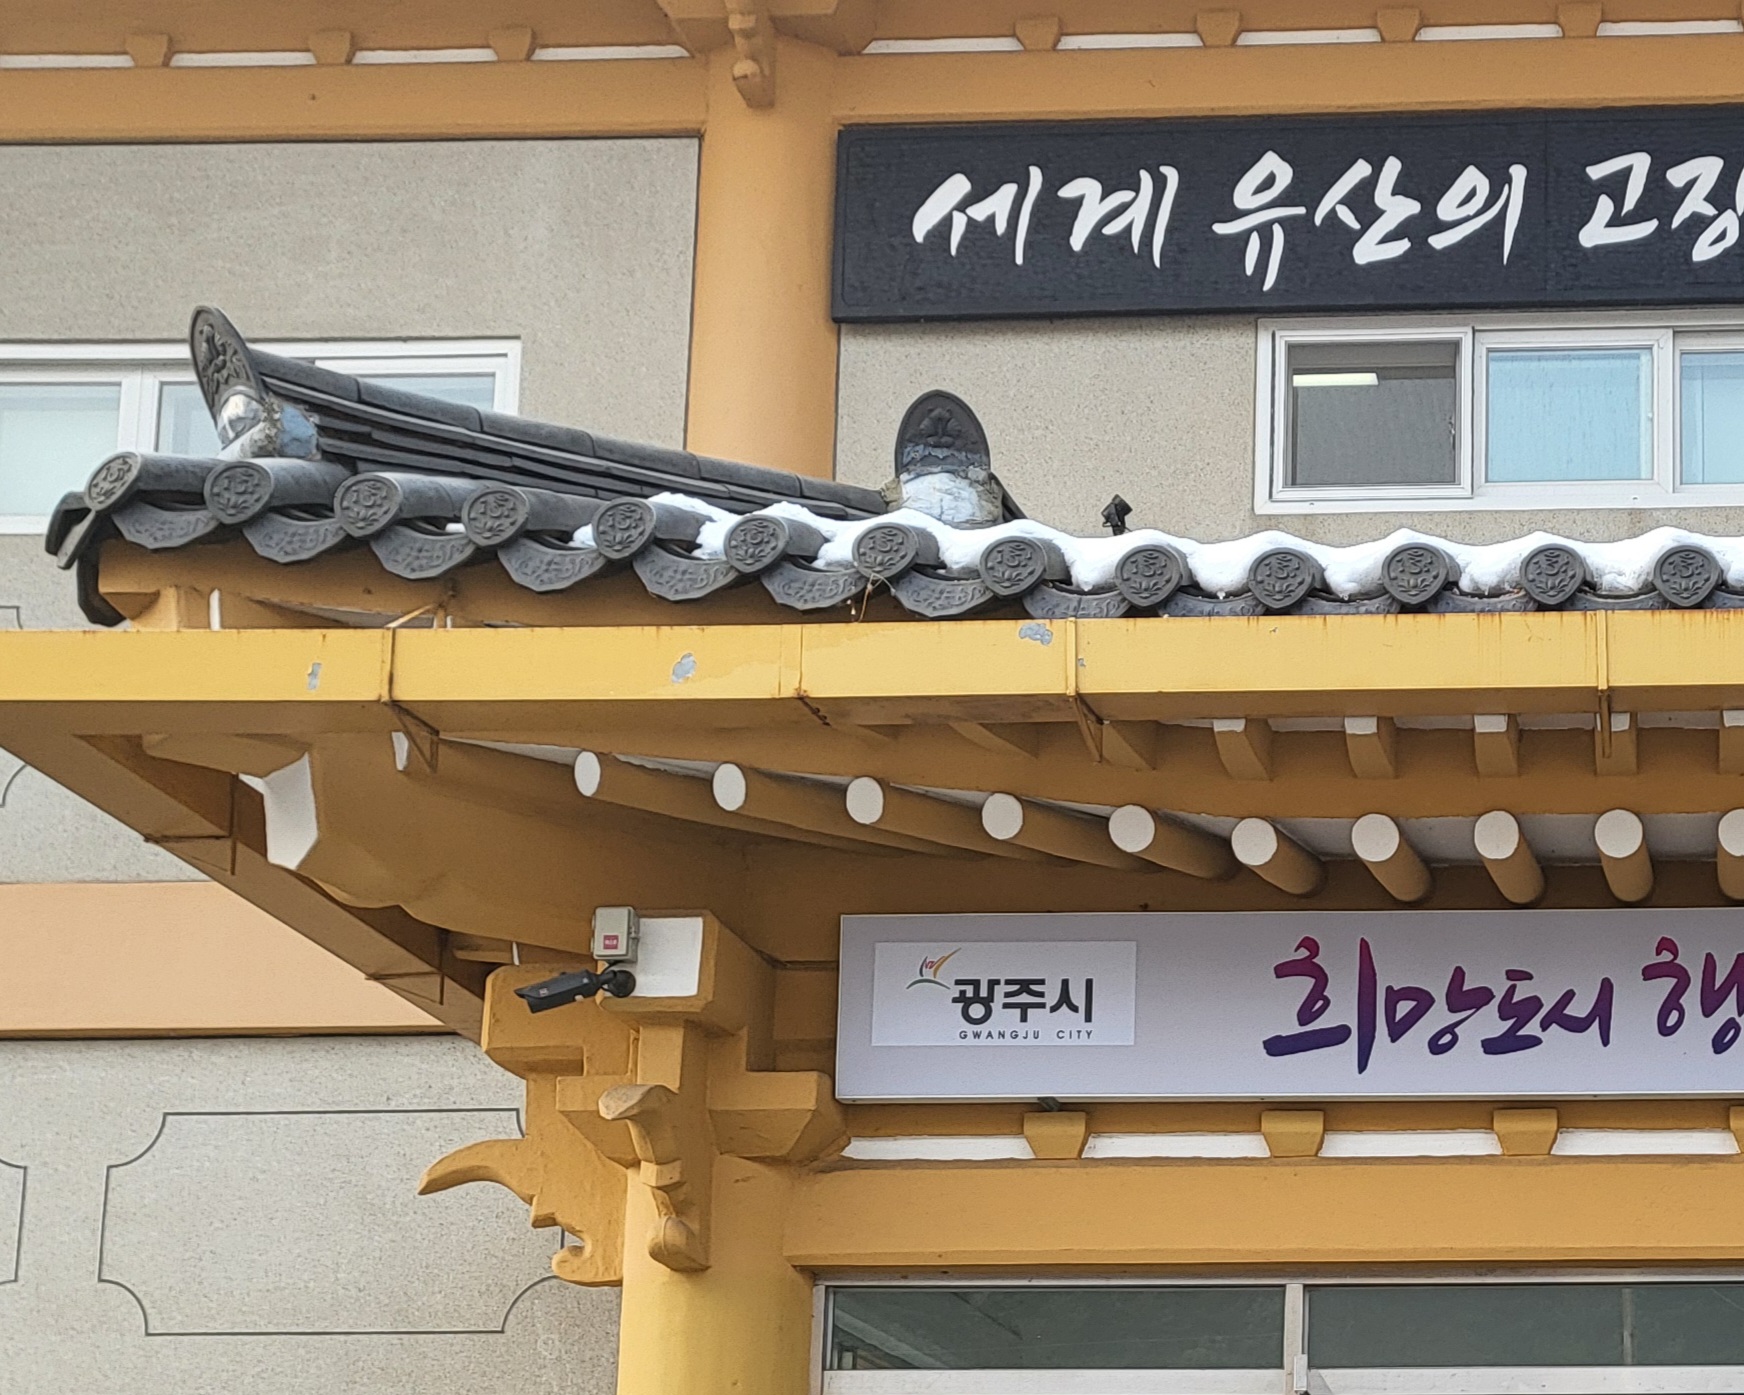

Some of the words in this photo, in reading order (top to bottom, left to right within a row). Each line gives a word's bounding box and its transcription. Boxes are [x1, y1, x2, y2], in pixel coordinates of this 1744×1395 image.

[914, 166, 1180, 269] 세계
[1213, 151, 1528, 292] 유산의
[952, 978, 1095, 1027] 광주시
[959, 1030, 1041, 1041] GWANGJU
[1056, 1030, 1094, 1041] CITY
